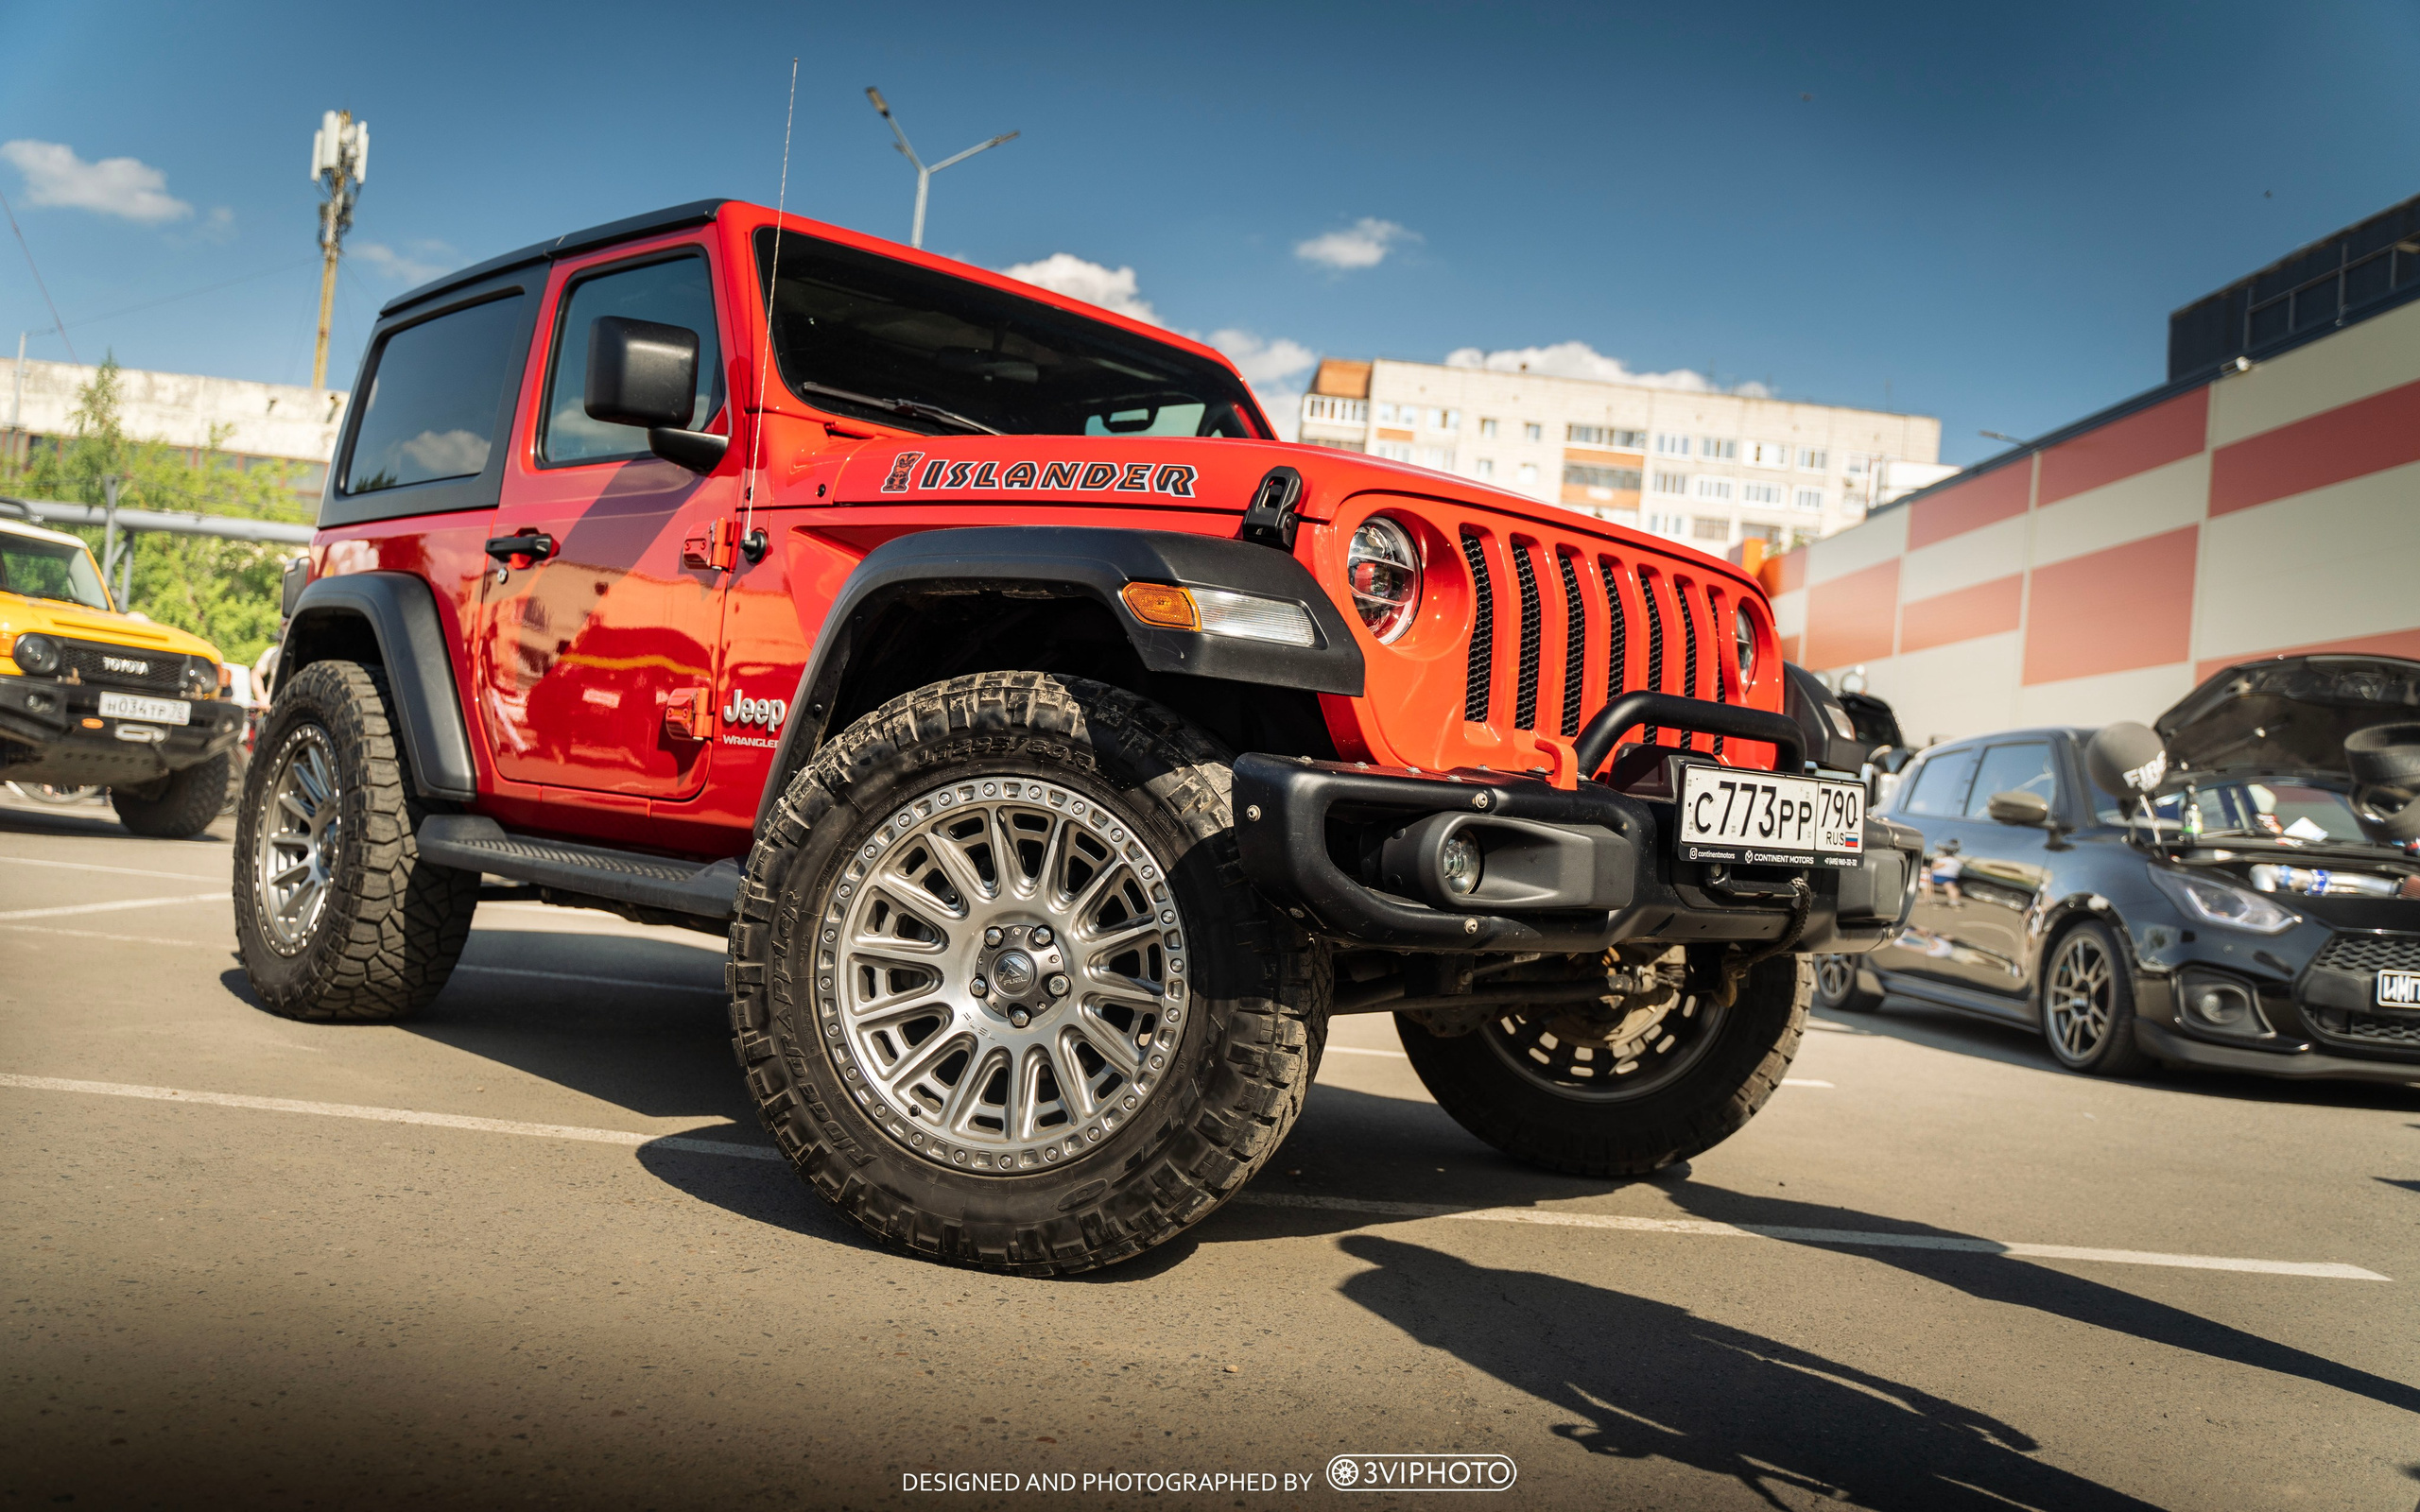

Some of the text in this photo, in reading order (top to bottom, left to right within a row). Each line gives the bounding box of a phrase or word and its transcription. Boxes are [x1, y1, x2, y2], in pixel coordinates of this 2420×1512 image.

[918, 459, 1199, 498] ISLANDER
[102, 656, 149, 676] TOYOTA
[723, 689, 786, 732] Jeep
[1821, 788, 1858, 830] 790
[1825, 832, 1844, 846] RUS
[1698, 850, 1736, 860] continentmotors
[1754, 853, 1814, 865] CONTINENT MOTORS
[1003, 976, 1028, 987] FUEL
[961, 1012, 996, 1040] FUEL
